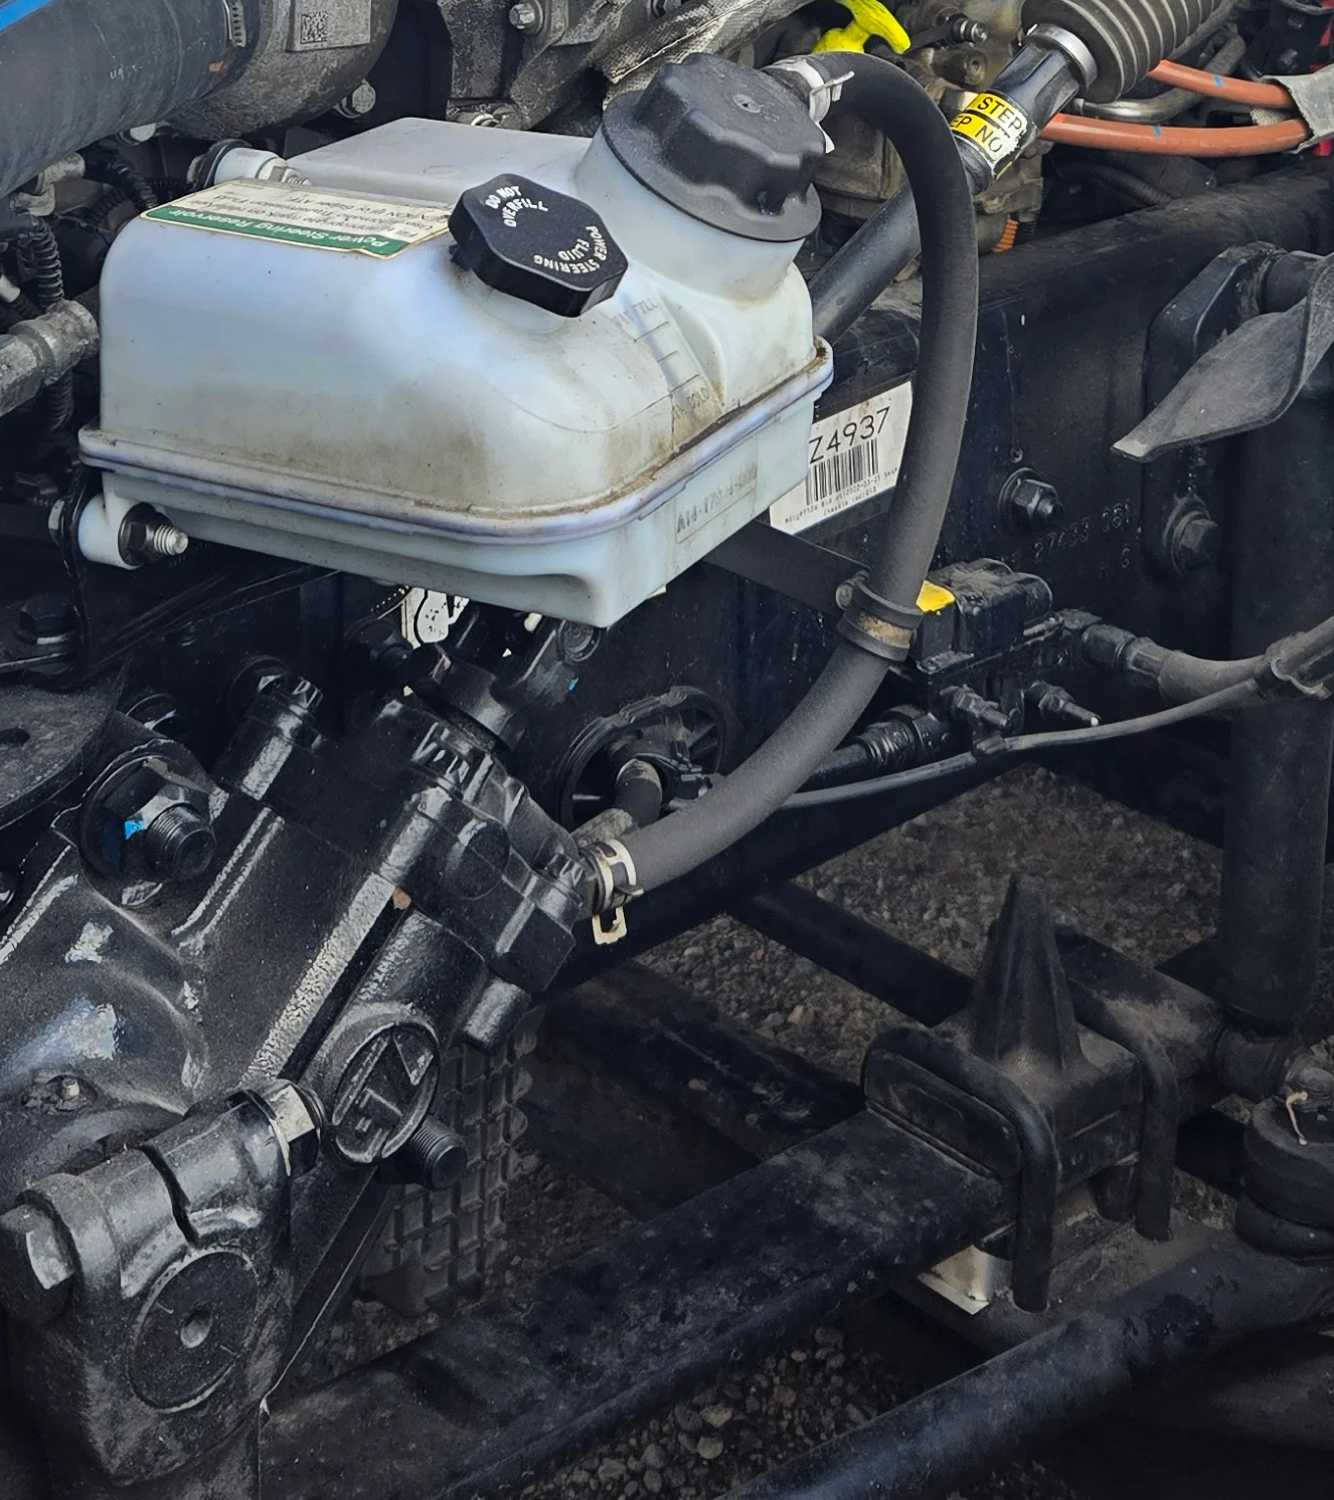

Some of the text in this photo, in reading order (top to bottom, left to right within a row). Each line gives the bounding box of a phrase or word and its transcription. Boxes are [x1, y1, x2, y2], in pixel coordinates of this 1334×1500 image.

[950, 115, 972, 128] EP
[977, 96, 1022, 130] STEP
[485, 185, 521, 209] DO NOT
[503, 197, 548, 227] OVERFILL
[168, 207, 388, 247] Power Steering Reservoir
[533, 225, 607, 274] POWER STEERING
[557, 238, 589, 260] FLUID
[810, 405, 893, 464] Z4937
